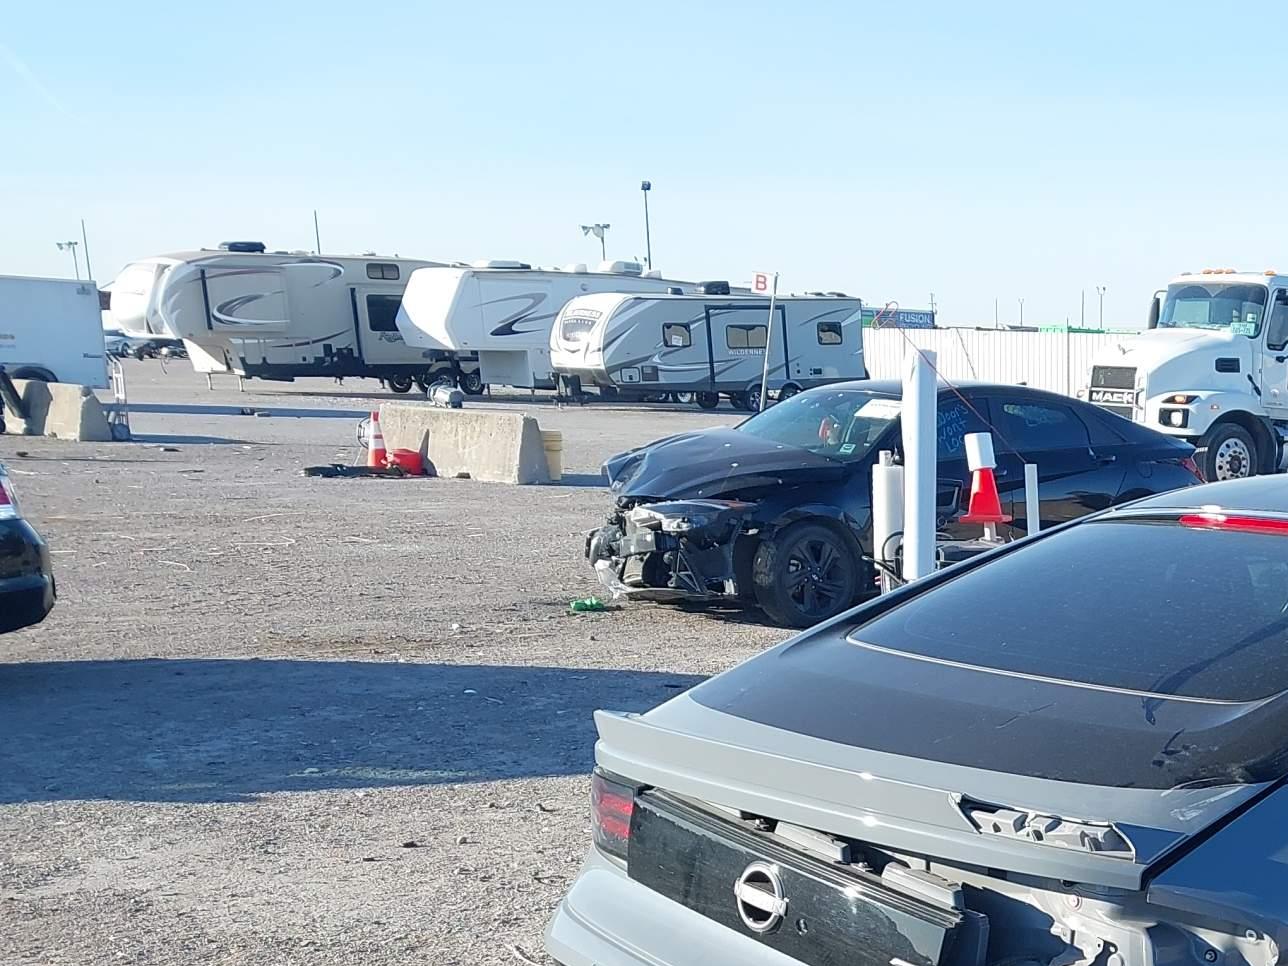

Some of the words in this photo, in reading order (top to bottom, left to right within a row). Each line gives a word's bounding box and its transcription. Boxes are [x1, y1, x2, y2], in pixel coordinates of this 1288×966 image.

[755, 274, 768, 291] B
[900, 312, 930, 323] FUSION
[1092, 391, 1134, 404] MACK
